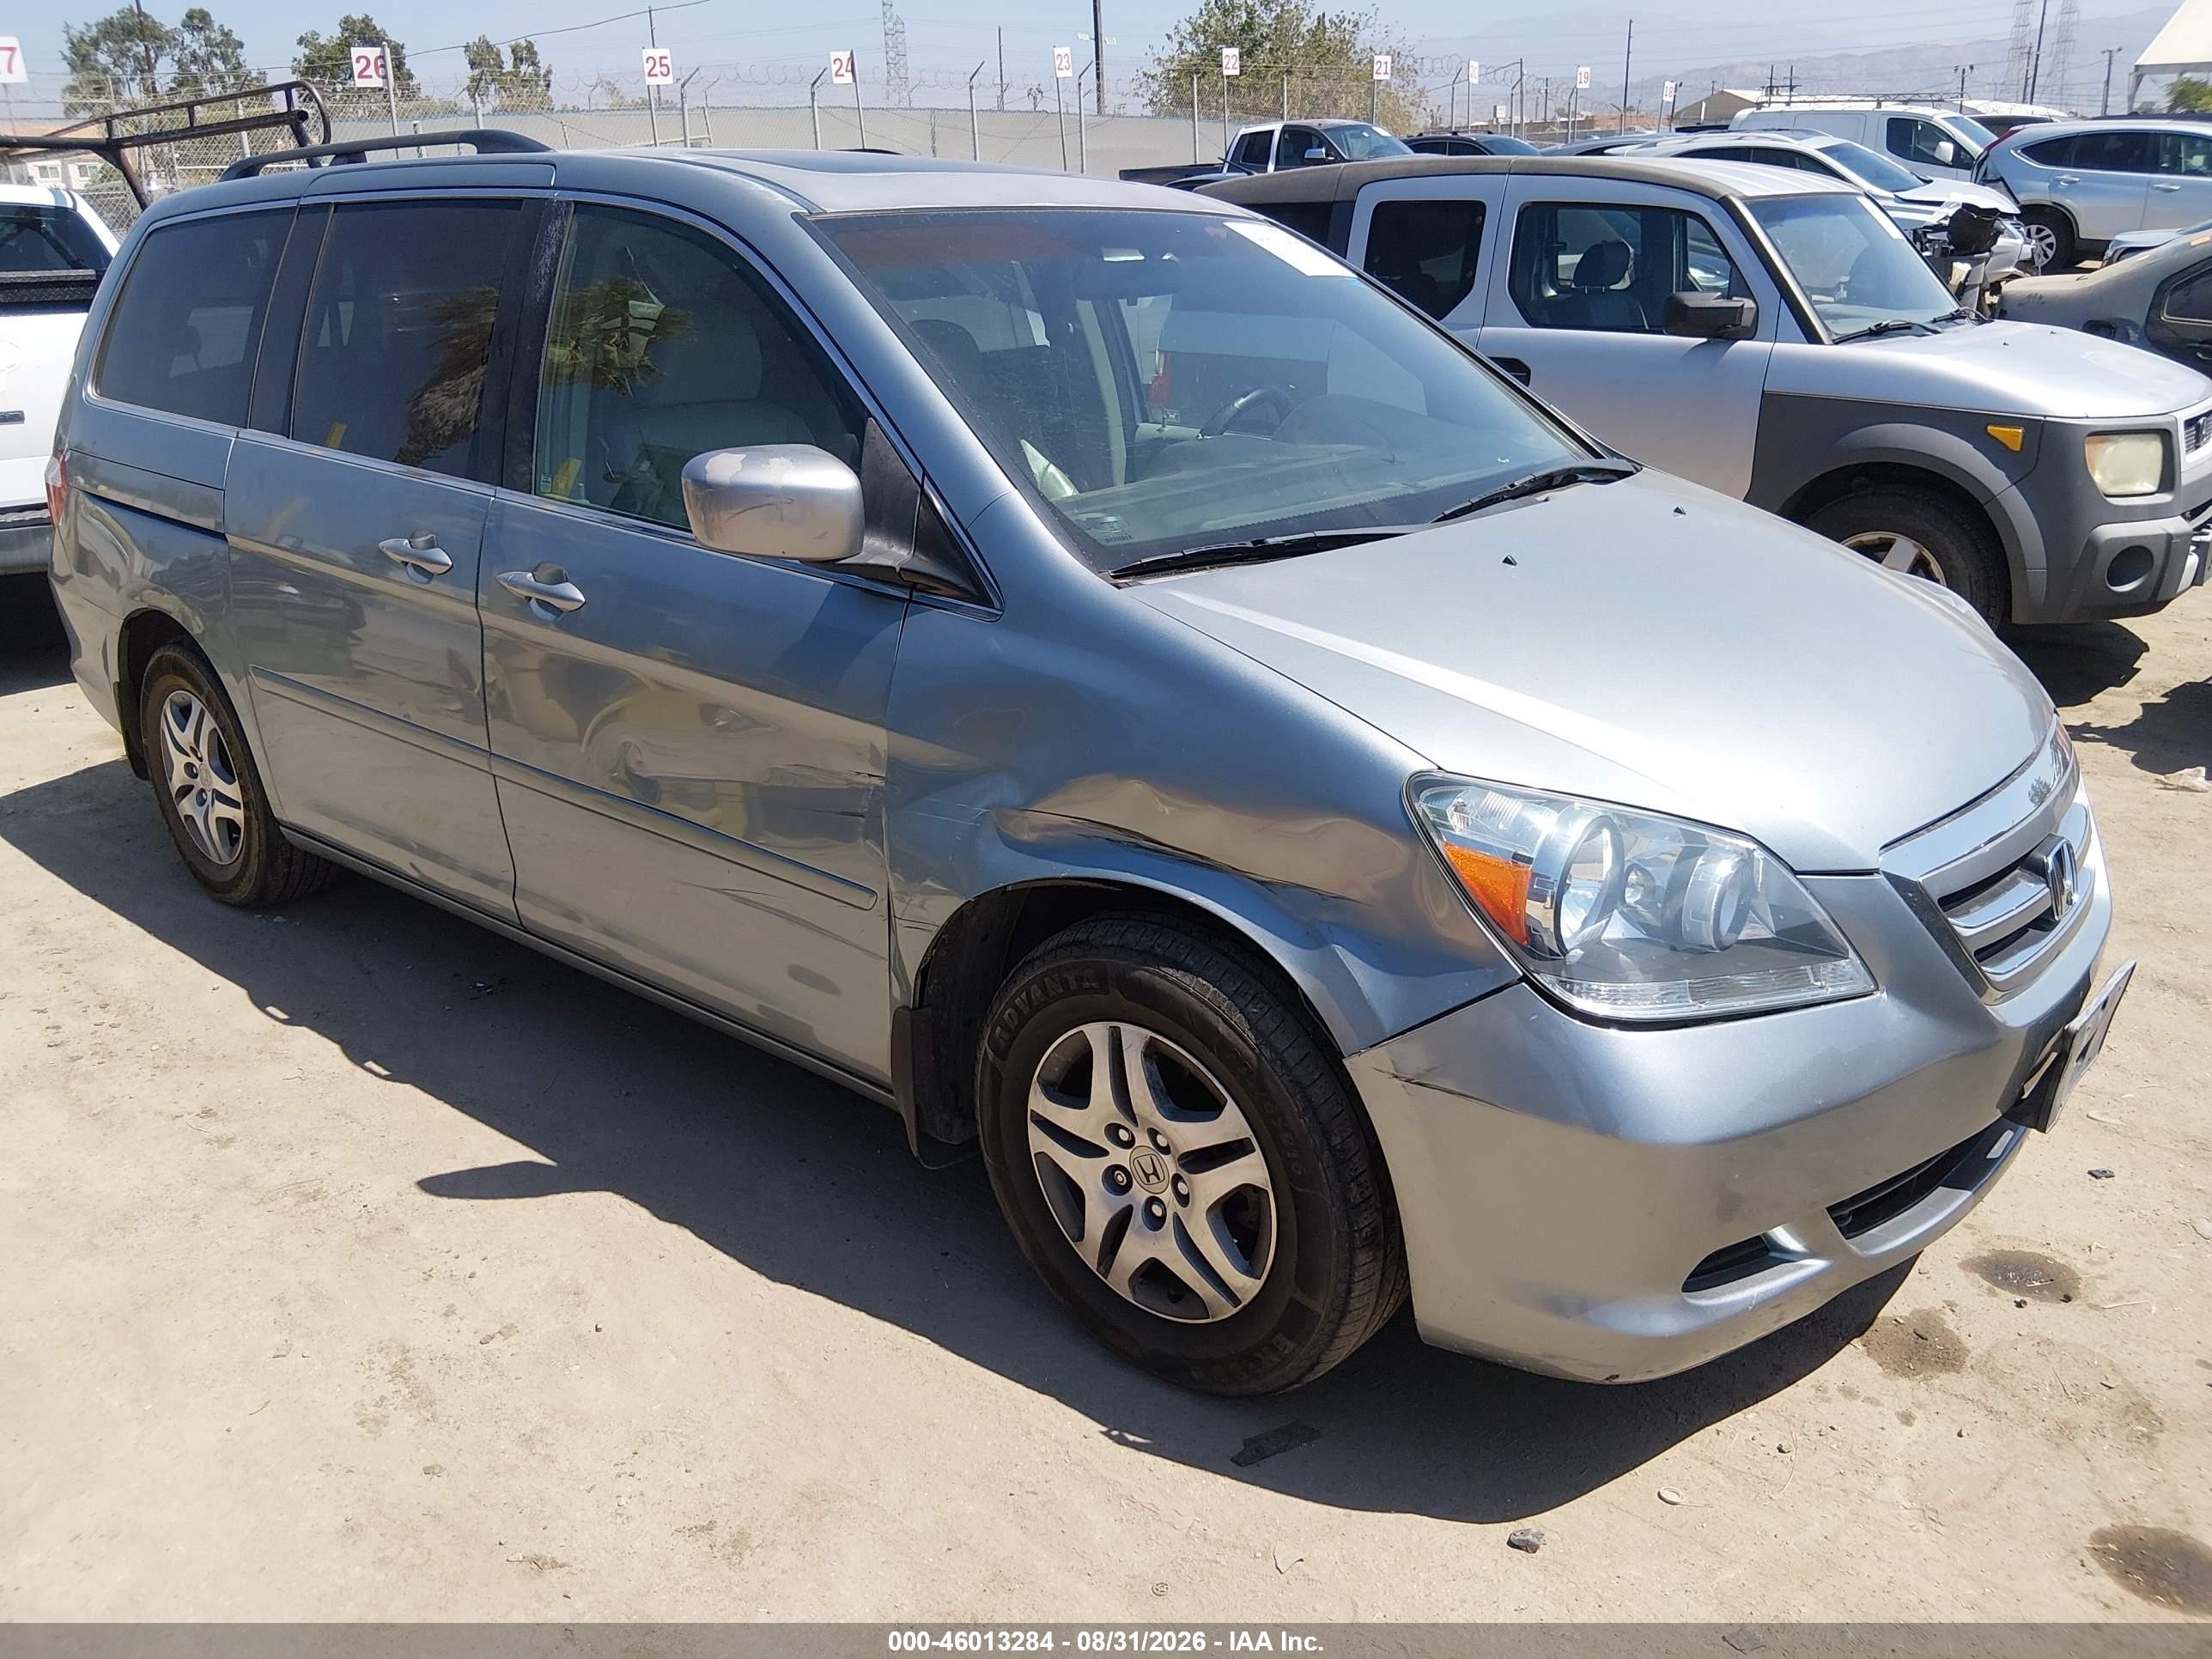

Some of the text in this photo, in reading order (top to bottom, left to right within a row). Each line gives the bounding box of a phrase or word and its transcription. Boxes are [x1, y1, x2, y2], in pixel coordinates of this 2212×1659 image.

[0, 46, 17, 75] 7
[355, 55, 386, 79] 26
[645, 56, 670, 77] 25
[833, 57, 853, 77] 24
[1055, 52, 1070, 70] 23
[1224, 54, 1237, 70] 22
[1375, 60, 1389, 75] 21
[1577, 70, 1589, 84] 19
[1663, 85, 1674, 98] 18
